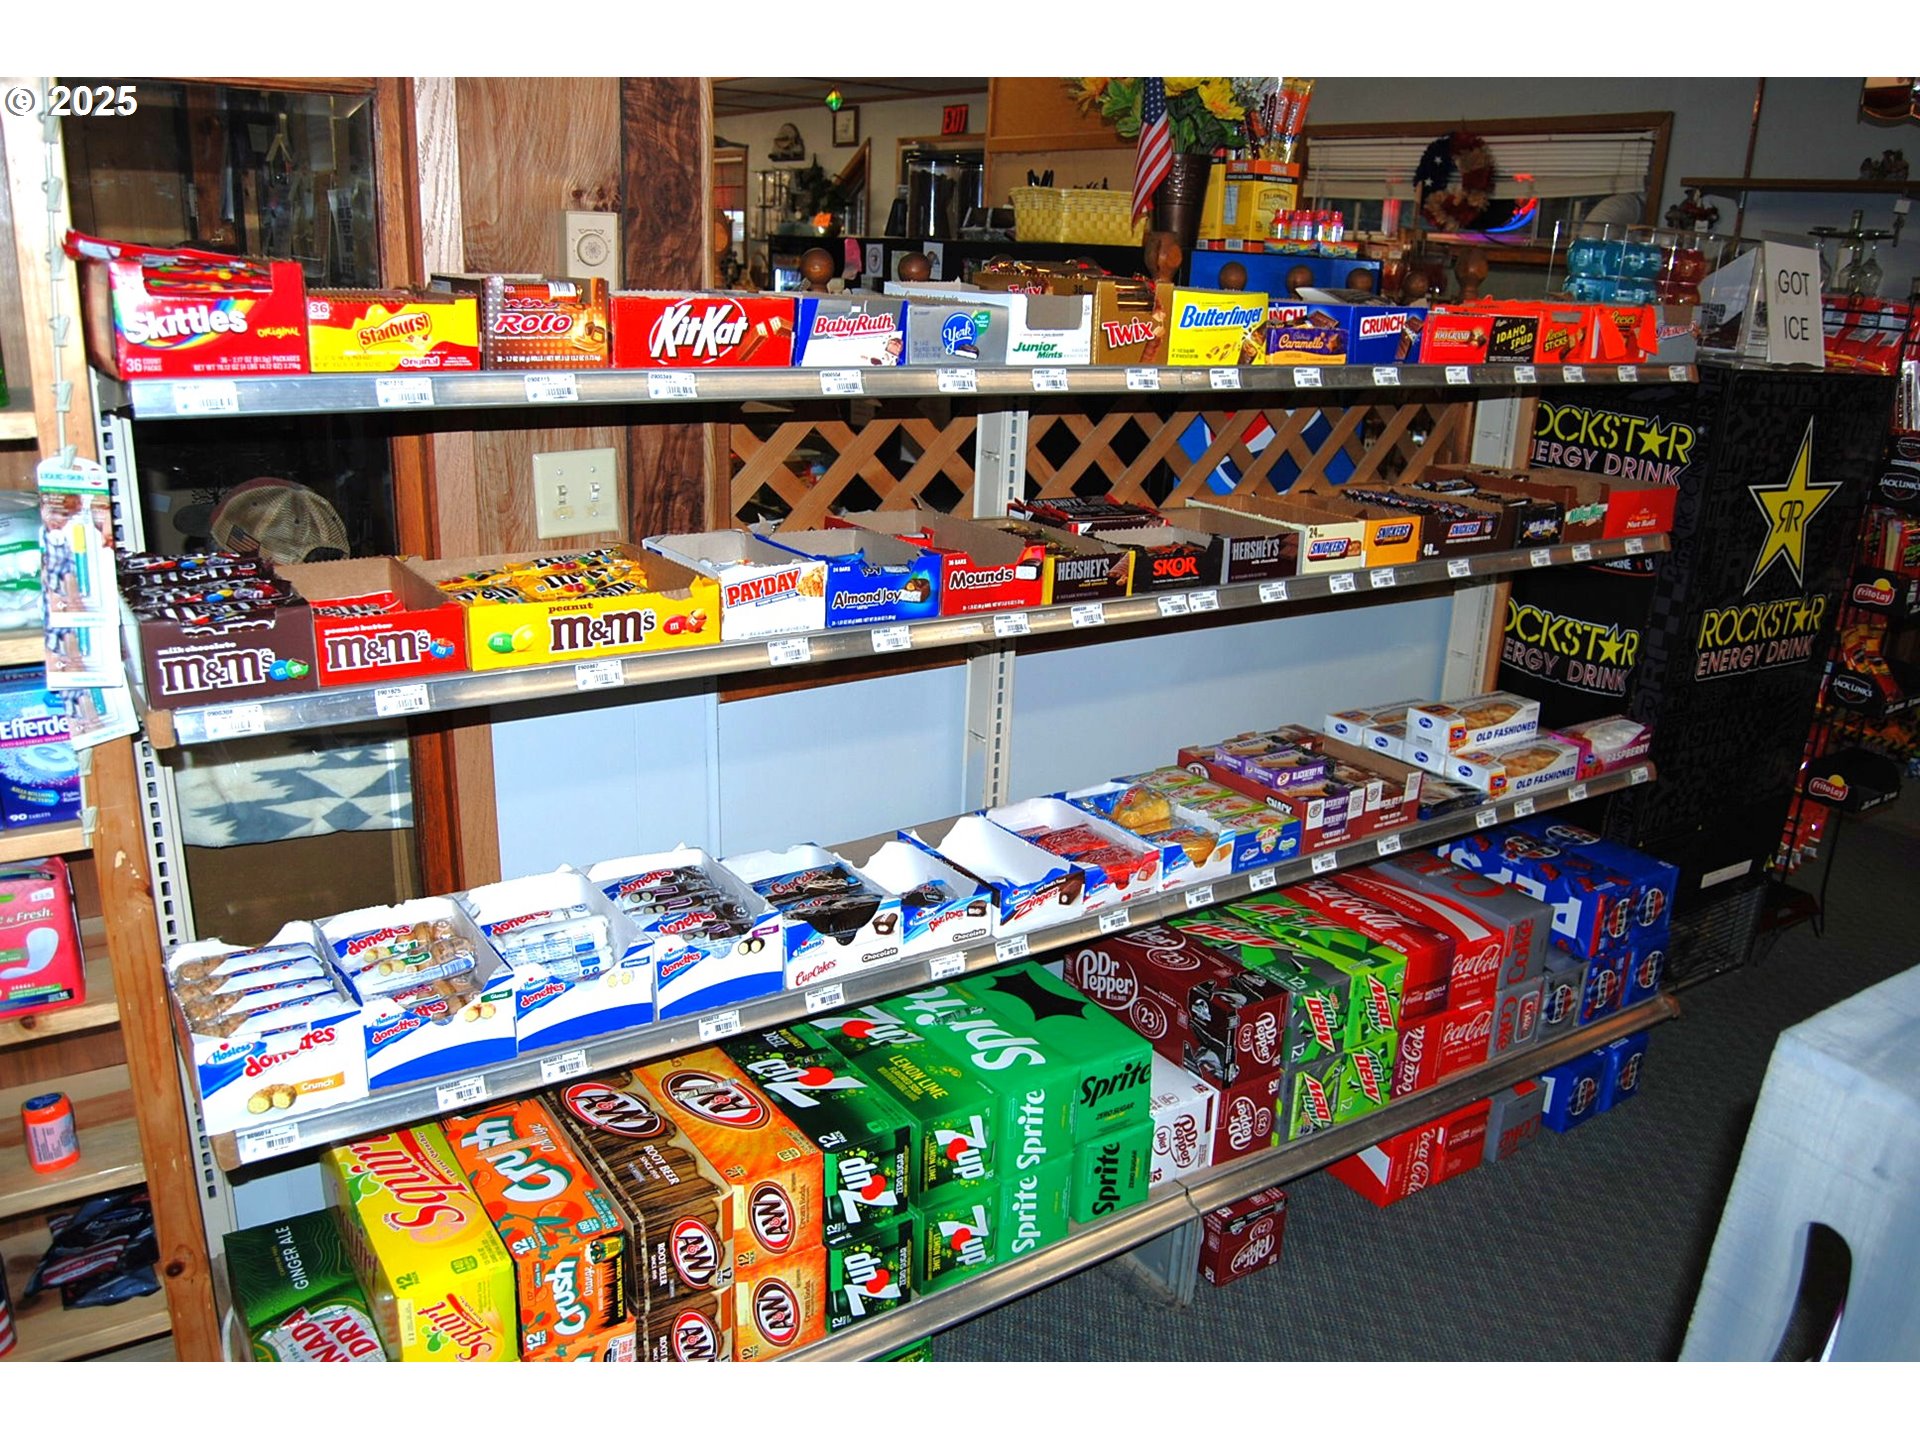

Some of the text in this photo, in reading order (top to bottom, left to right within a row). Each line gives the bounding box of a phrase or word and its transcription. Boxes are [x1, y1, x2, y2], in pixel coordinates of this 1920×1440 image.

[943, 106, 967, 133] EXIT
[1778, 269, 1810, 296] GOT
[311, 303, 328, 313] 36
[1179, 304, 1263, 329] Butterfinger
[124, 304, 248, 344] Skittles
[359, 313, 430, 346] Starburst
[494, 313, 573, 333] Rolo
[1102, 315, 1155, 349] Twix
[1361, 315, 1405, 335] CRUNCH
[1497, 325, 1526, 345] IDAHO
[1784, 315, 1810, 340] ICE
[943, 321, 974, 355] York
[1013, 341, 1058, 353] Junior
[1279, 334, 1324, 349] Caramello
[1510, 333, 1533, 350] SPUD
[126, 358, 142, 372] 36
[402, 357, 439, 367] Original
[1036, 350, 1063, 359] Mints
[1603, 452, 1681, 486] DRINK
[1309, 527, 1318, 538] 24
[1376, 524, 1411, 539] SNICKERS
[1449, 522, 1480, 535] SNICKERS
[1627, 519, 1640, 528] Nut
[1231, 538, 1280, 561] HERSHEY'S
[1310, 540, 1348, 555] SNICKERS
[949, 566, 1015, 590] Mounds
[1057, 558, 1110, 581] HERSHEY'S
[1153, 556, 1200, 577] SKOR
[726, 568, 801, 606] PAYDAY
[831, 587, 902, 609] Almond Joy
[548, 602, 593, 614] peanut
[1699, 635, 1814, 676] ENERGY DRINK
[1567, 659, 1628, 692] DRINK
[1, 715, 71, 741] Efferde
[1475, 720, 1537, 743] OLD FASHIONED
[1516, 766, 1576, 790] OLD FASHIONED
[1014, 887, 1060, 920] Zingers
[348, 925, 411, 956] donettes
[952, 928, 986, 942] Chocolate
[661, 952, 701, 977] donettes
[862, 947, 898, 963] Chocolate
[1098, 951, 1120, 976] Dr
[795, 959, 837, 987] CupCakes
[1083, 955, 1133, 999] Pepper
[521, 982, 565, 1008] donettes
[810, 1005, 926, 1046] 7up
[1140, 1007, 1155, 1022] 23
[372, 1018, 420, 1044] donettes
[1255, 1016, 1272, 1060] Pepper
[210, 1044, 252, 1064] Hostess
[301, 1078, 334, 1091] Crunch
[747, 1058, 868, 1108] 7up
[889, 1054, 949, 1100] LEMON LIME
[1080, 1061, 1151, 1108] Sprite
[568, 1093, 656, 1125] A&W
[818, 1131, 841, 1149] 12
[1016, 1087, 1047, 1171] Sprite
[1157, 1132, 1167, 1149] Diet
[1173, 1117, 1192, 1163] Pepper
[1185, 1129, 1198, 1149] Dr
[934, 1115, 987, 1180] 7up
[642, 1145, 681, 1186] ROOT BEER
[928, 1141, 938, 1183] LEMON LIME
[1152, 1168, 1162, 1182] 12
[838, 1157, 899, 1224] 7up
[1092, 1142, 1121, 1216] Sprite
[753, 1199, 790, 1236] A&W
[1011, 1174, 1041, 1254] Sprite
[512, 1237, 531, 1255] 12
[937, 1204, 990, 1266] 7up
[275, 1225, 309, 1290] GINGER ALE
[657, 1242, 668, 1287] ROOT BEER
[679, 1236, 718, 1280] A&W
[738, 1252, 750, 1267] 12
[932, 1232, 942, 1272] LEMON LIME
[396, 1273, 412, 1290] 12
[583, 1266, 595, 1297] Orange
[844, 1251, 902, 1317] 7up
[544, 1258, 580, 1336] Crush
[758, 1294, 795, 1330] A&W
[322, 1314, 379, 1358] DRY
[417, 1300, 493, 1361] Squirt
